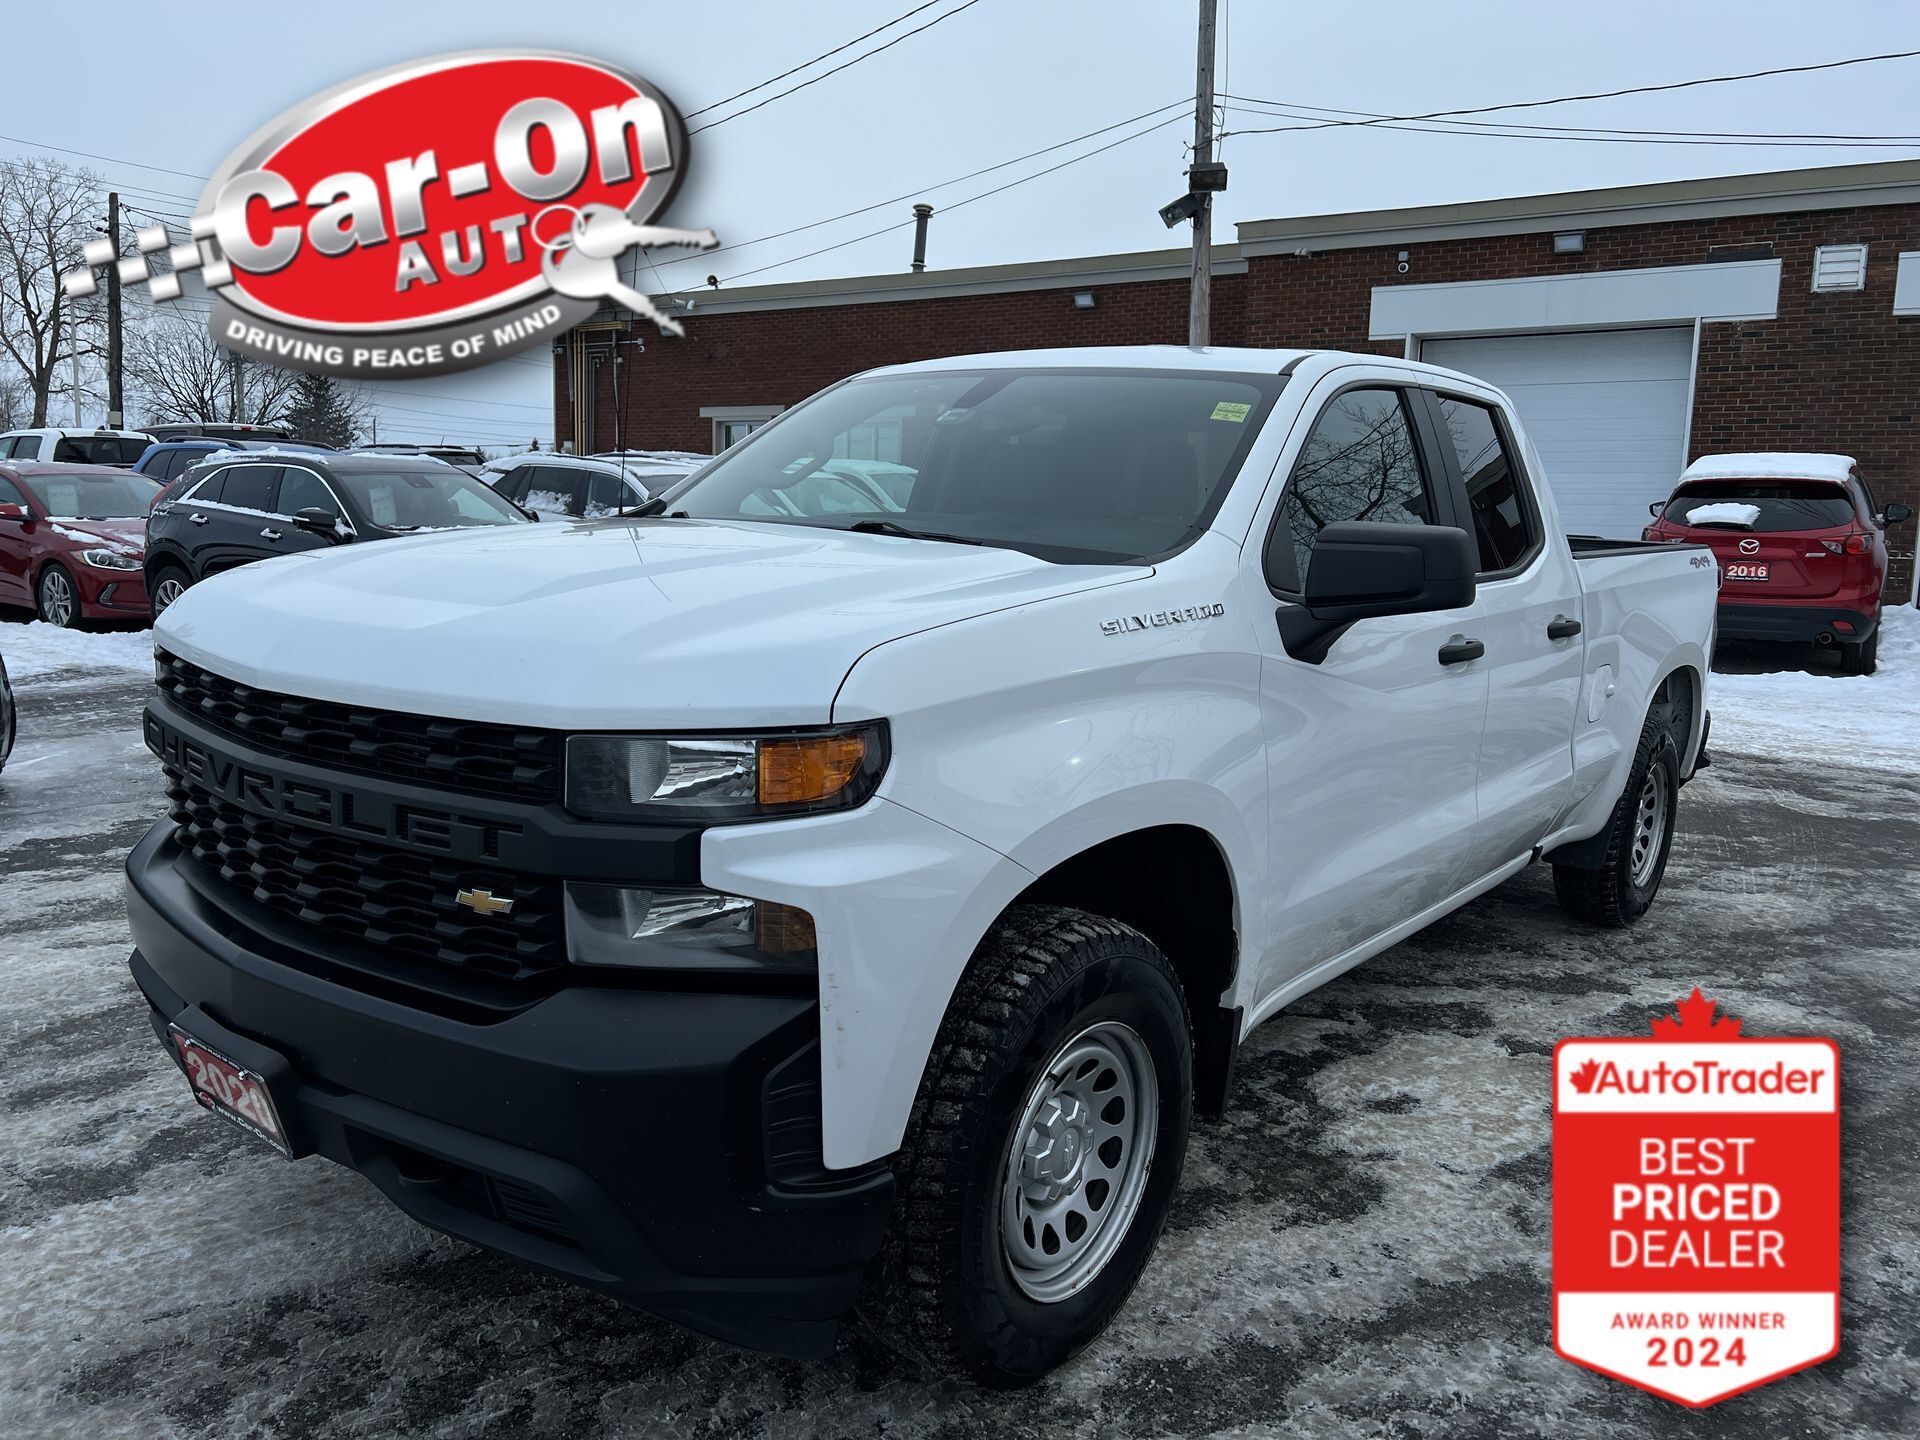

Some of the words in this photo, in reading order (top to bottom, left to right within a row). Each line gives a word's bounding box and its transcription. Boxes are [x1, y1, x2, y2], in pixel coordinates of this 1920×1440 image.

[1727, 565, 1767, 577] 2016
[1100, 603, 1225, 636] SILVERADO
[147, 718, 525, 858] CHEVROLET
[186, 1050, 278, 1134] 2020
